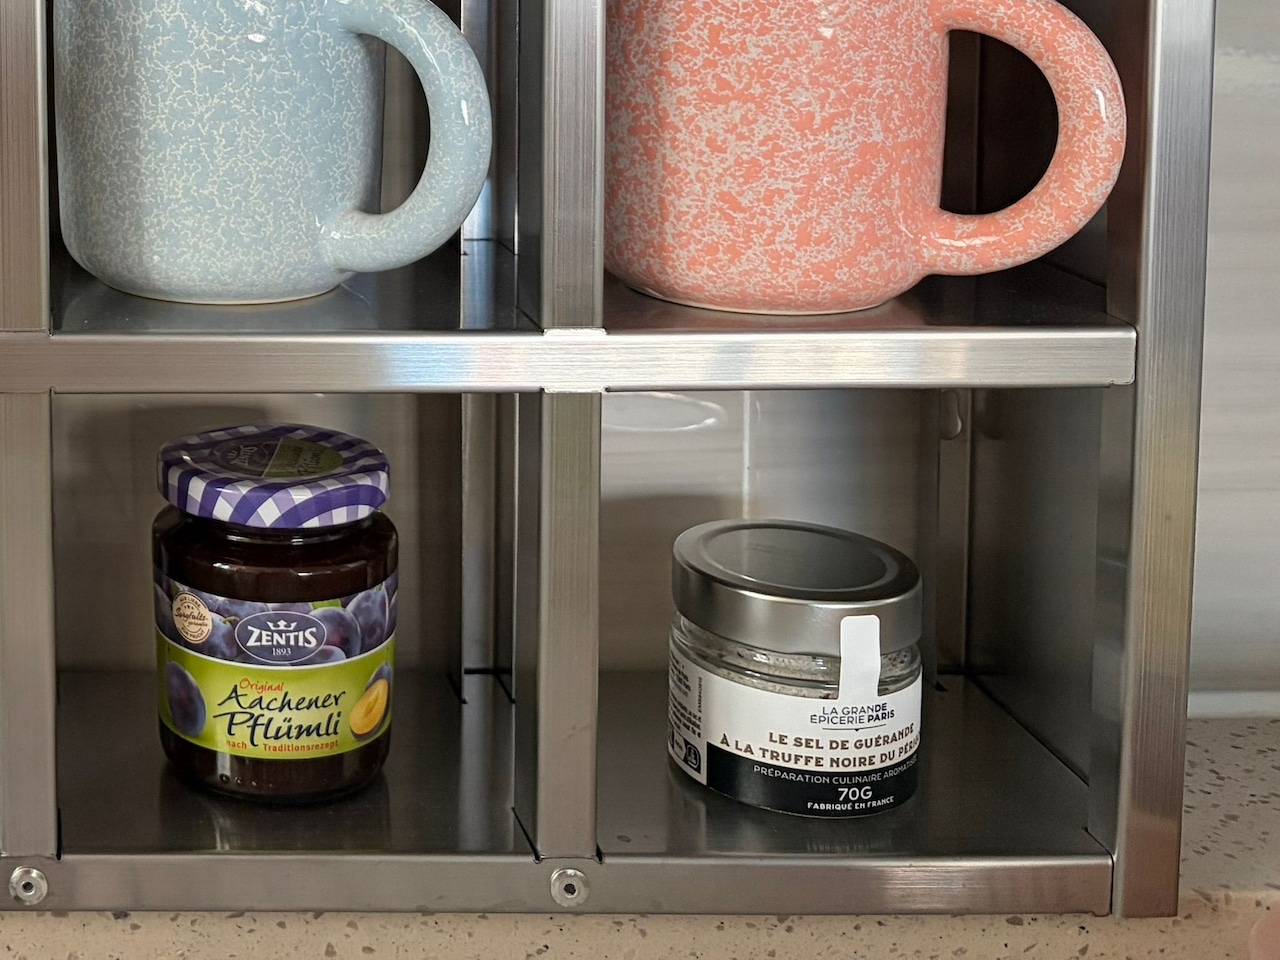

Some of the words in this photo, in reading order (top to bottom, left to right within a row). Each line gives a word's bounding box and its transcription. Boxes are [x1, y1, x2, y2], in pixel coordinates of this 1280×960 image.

[246, 625, 319, 648] ZENTIS
[272, 647, 292, 657] 1893
[239, 678, 284, 695] Original
[217, 684, 346, 714] Aachener
[810, 713, 865, 725] ÉPICERIE
[867, 709, 895, 724] PARIS
[822, 706, 838, 716] LA
[841, 702, 888, 716] GRANDE
[213, 710, 341, 748] Pflümli
[768, 731, 788, 745] LE
[792, 736, 824, 750] SEL
[829, 739, 849, 751] DE
[853, 722, 915, 750] GUÉRANDE
[226, 740, 248, 751] nach
[262, 739, 339, 753] Traditionsrezept
[720, 732, 730, 747] À
[734, 741, 754, 756] LA
[759, 747, 824, 768] TRUFFE
[829, 755, 875, 768] NOIRE
[880, 749, 895, 763] DU
[753, 765, 830, 784] PRÉPARATION
[832, 773, 883, 785] CULINAIRE
[837, 786, 873, 802] 70G
[807, 801, 853, 811] FABRIQUÉ
[854, 801, 866, 810] EN
[867, 795, 895, 808] FRANCE
